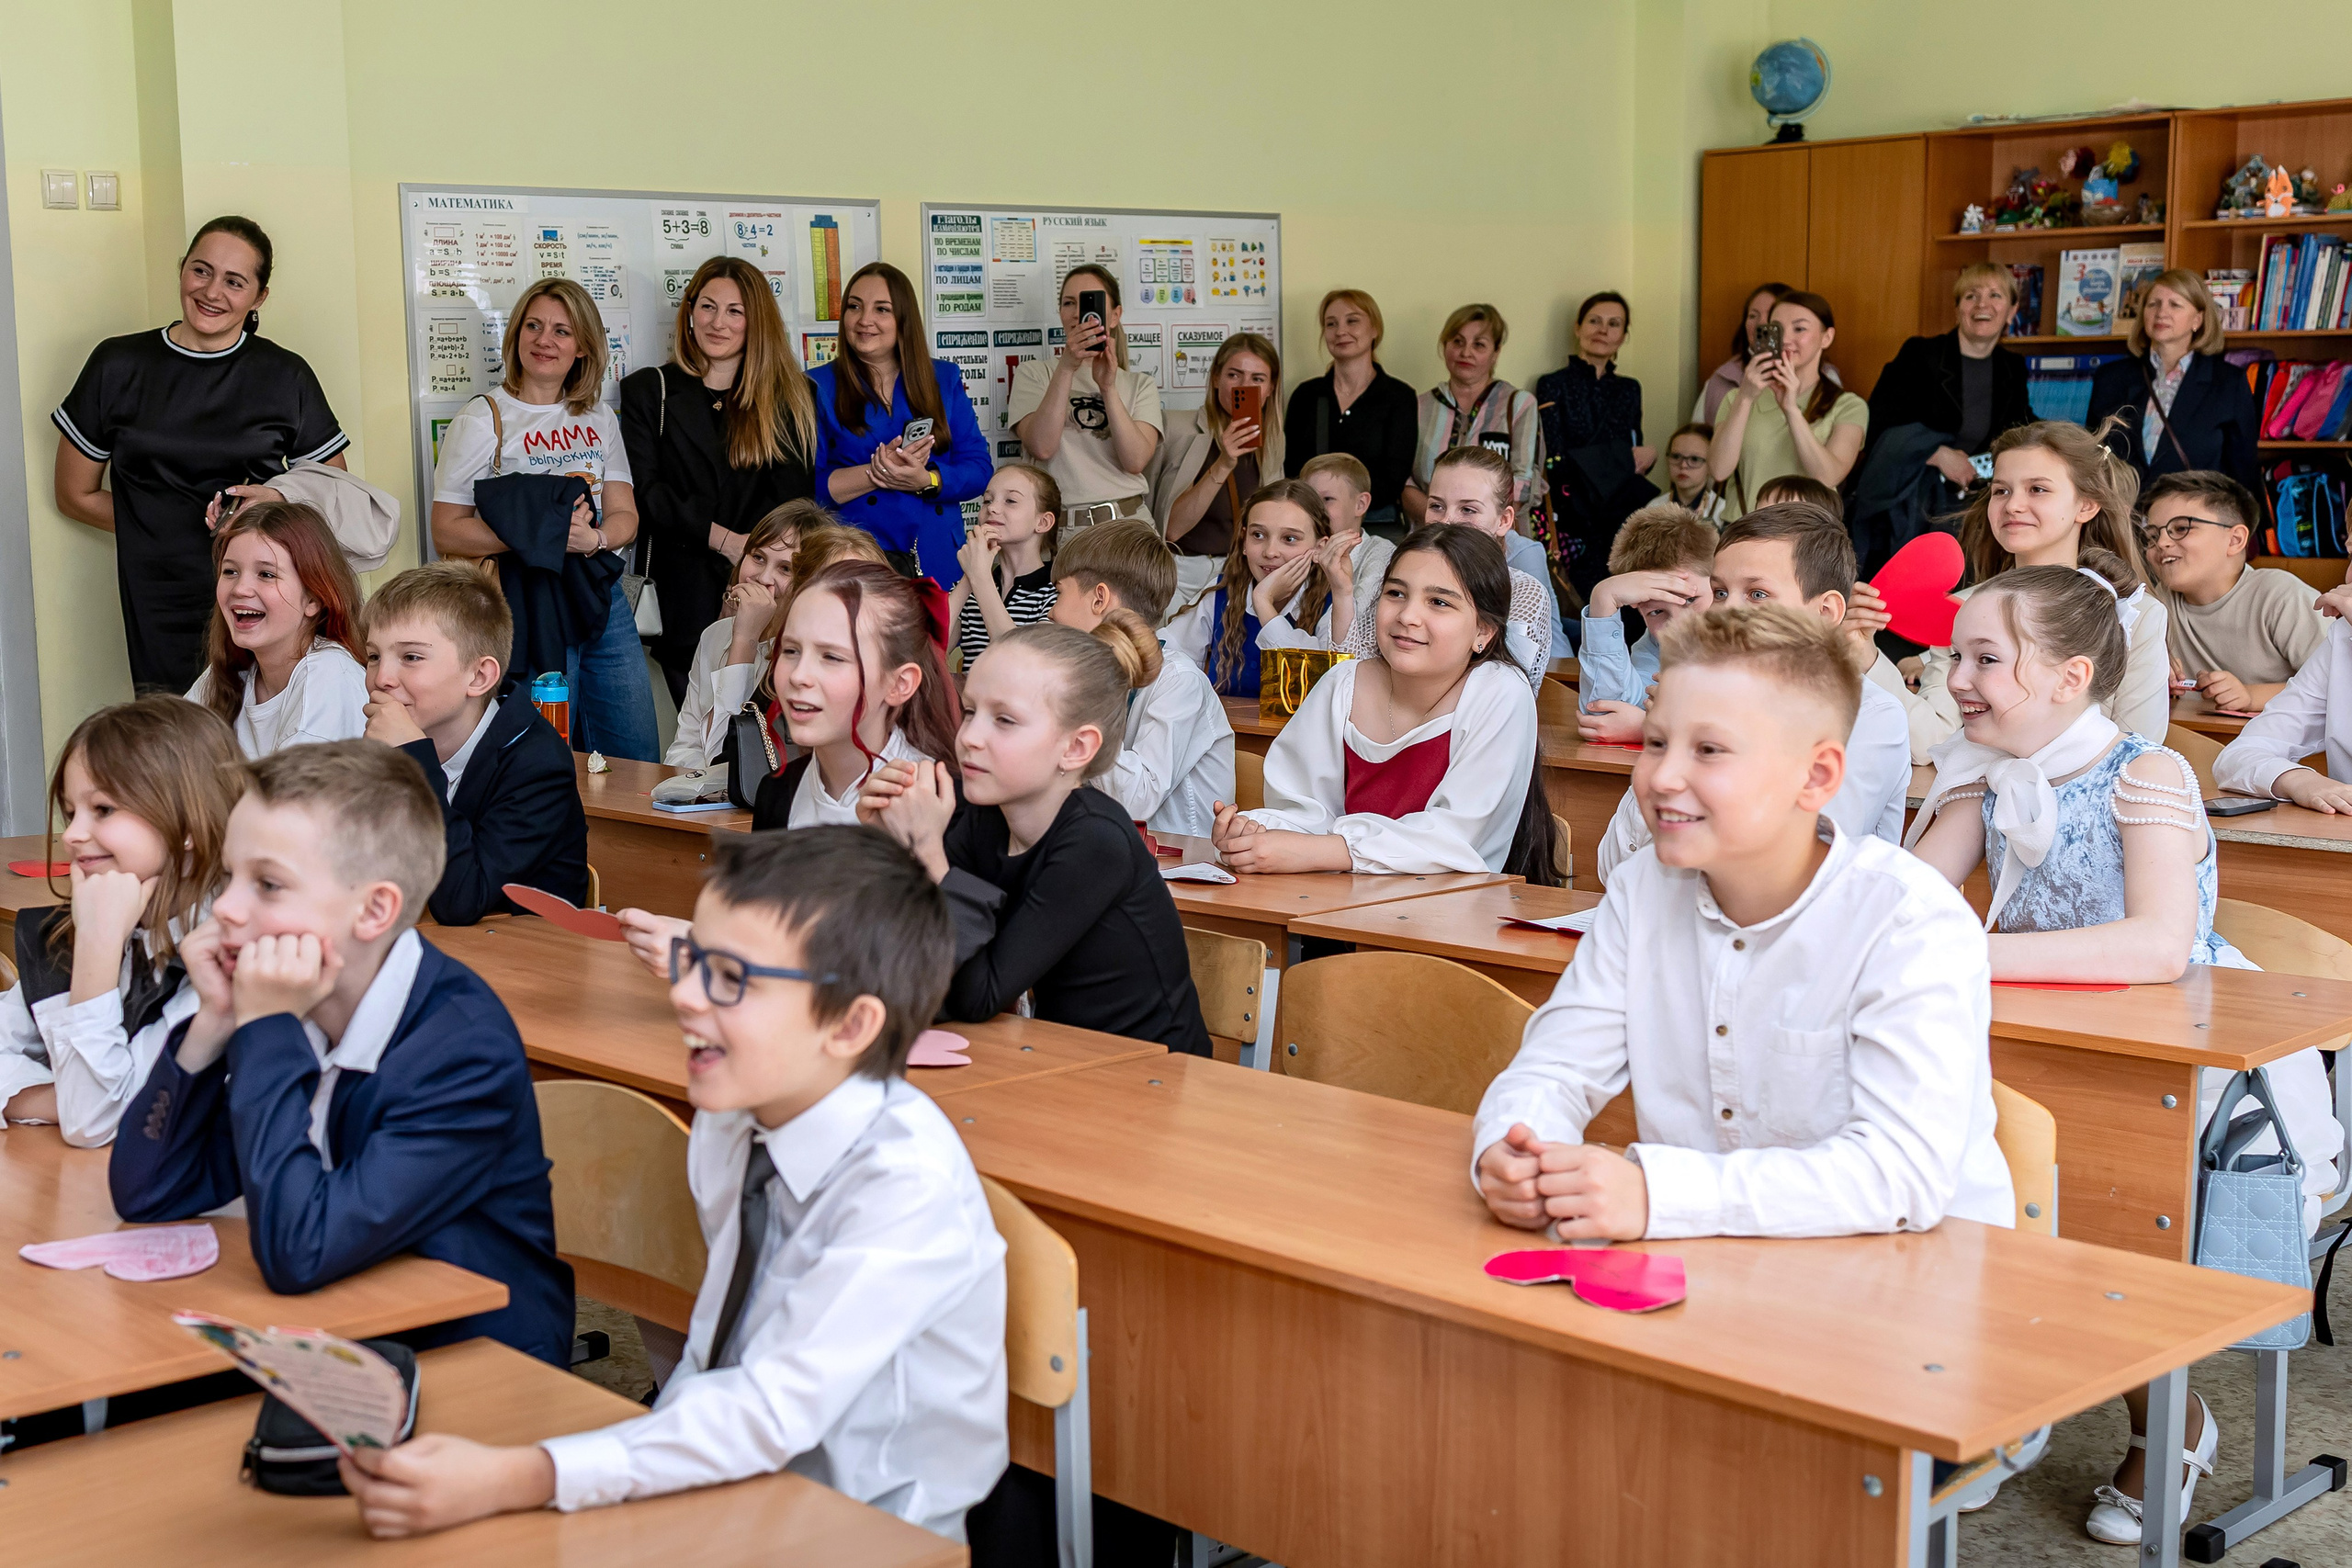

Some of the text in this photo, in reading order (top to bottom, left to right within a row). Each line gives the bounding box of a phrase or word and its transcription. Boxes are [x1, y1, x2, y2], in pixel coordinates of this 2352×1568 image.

[428, 197, 514, 209] МАТЕМАТИКА
[1043, 215, 1108, 227] РУССКИЙ ЯЗЫК
[945, 238, 981, 246] ВРЕМЕНАМ
[936, 247, 980, 255] ПО ЧИСЛАМ
[935, 276, 981, 284] ПО ЛИЦАМ
[938, 303, 981, 311] ПО РОДАМ
[1128, 333, 1161, 344] ЕЖАЩЕЕ
[1177, 331, 1224, 341] СКАЗУЕМОЕ
[952, 355, 988, 365] остальные
[959, 368, 986, 379] голы
[524, 424, 603, 455] МАМА
